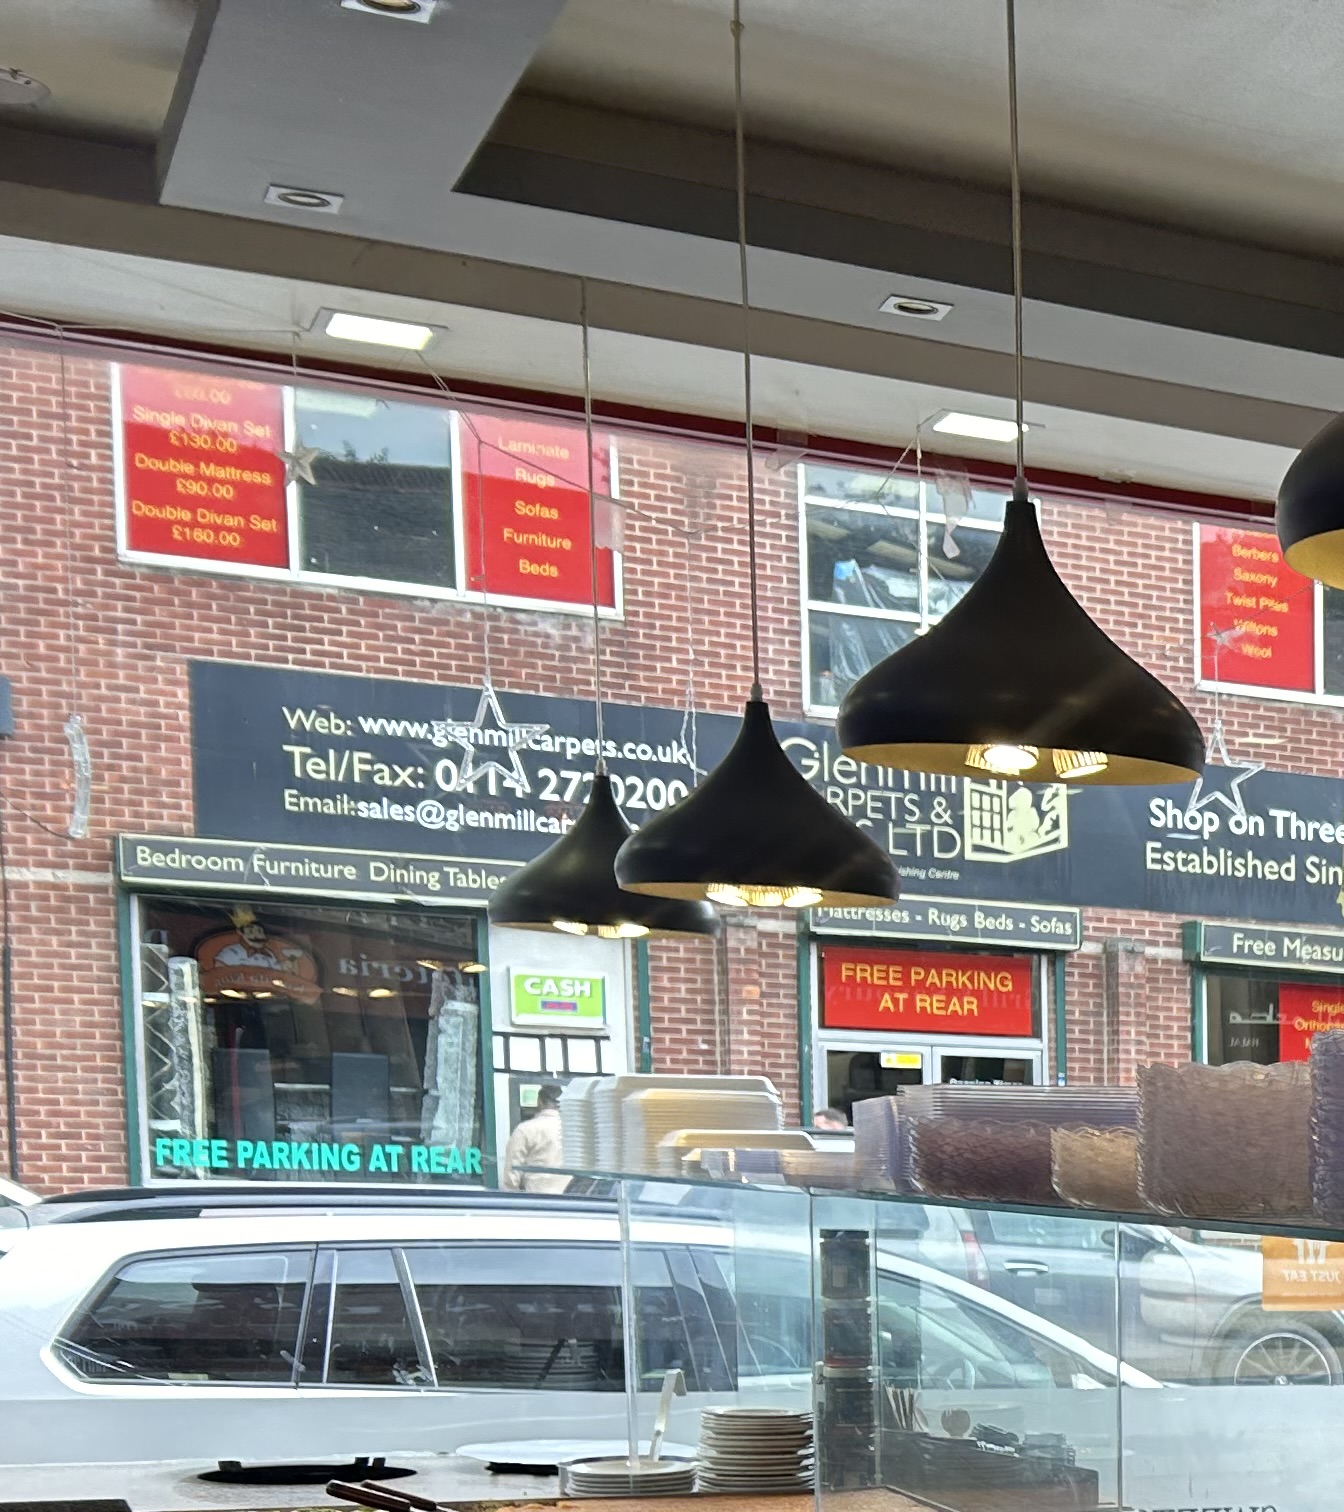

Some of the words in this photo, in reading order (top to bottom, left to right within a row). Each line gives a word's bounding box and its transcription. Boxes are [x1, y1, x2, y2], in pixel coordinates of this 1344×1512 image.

[133, 405, 185, 427] Single
[191, 413, 238, 433] Divan
[244, 420, 272, 438] Set
[169, 431, 237, 453] £130.00
[498, 436, 570, 460] Laminate
[135, 453, 195, 475] Double
[199, 461, 272, 486] Mattress
[515, 468, 556, 489] Rugs
[176, 478, 234, 498] £90.00
[132, 501, 192, 522] Double
[197, 508, 244, 528] Divan
[249, 515, 278, 532] Set
[514, 500, 559, 520] Sofas
[503, 528, 573, 550] Furniture
[519, 558, 559, 578] Beds
[1233, 567, 1278, 588] Saxony
[1225, 591, 1256, 609] Twist
[282, 707, 353, 738] Web:
[282, 745, 424, 790] Tel/Fax:
[827, 786, 921, 820] RPETS
[931, 797, 953, 824] &
[1149, 798, 1220, 840] Shop
[1229, 814, 1265, 837] on
[889, 823, 962, 859] LTD
[136, 846, 244, 873] Bedroom
[253, 853, 357, 881] Furniture
[370, 862, 440, 891] Dining
[1146, 841, 1296, 882] Established
[928, 908, 968, 932] Rugs
[974, 911, 1013, 931] Beds
[1030, 917, 1073, 936] Sofas
[1232, 933, 1276, 958] Free
[524, 977, 592, 998] CASH
[841, 962, 903, 986] FREE
[910, 966, 1013, 993] PARKING
[878, 992, 909, 1013] AT
[916, 994, 979, 1017] REAR
[156, 1138, 230, 1168] FREE
[237, 1140, 361, 1172] PARKING
[368, 1144, 403, 1173] AT
[411, 1145, 483, 1175] REAR
